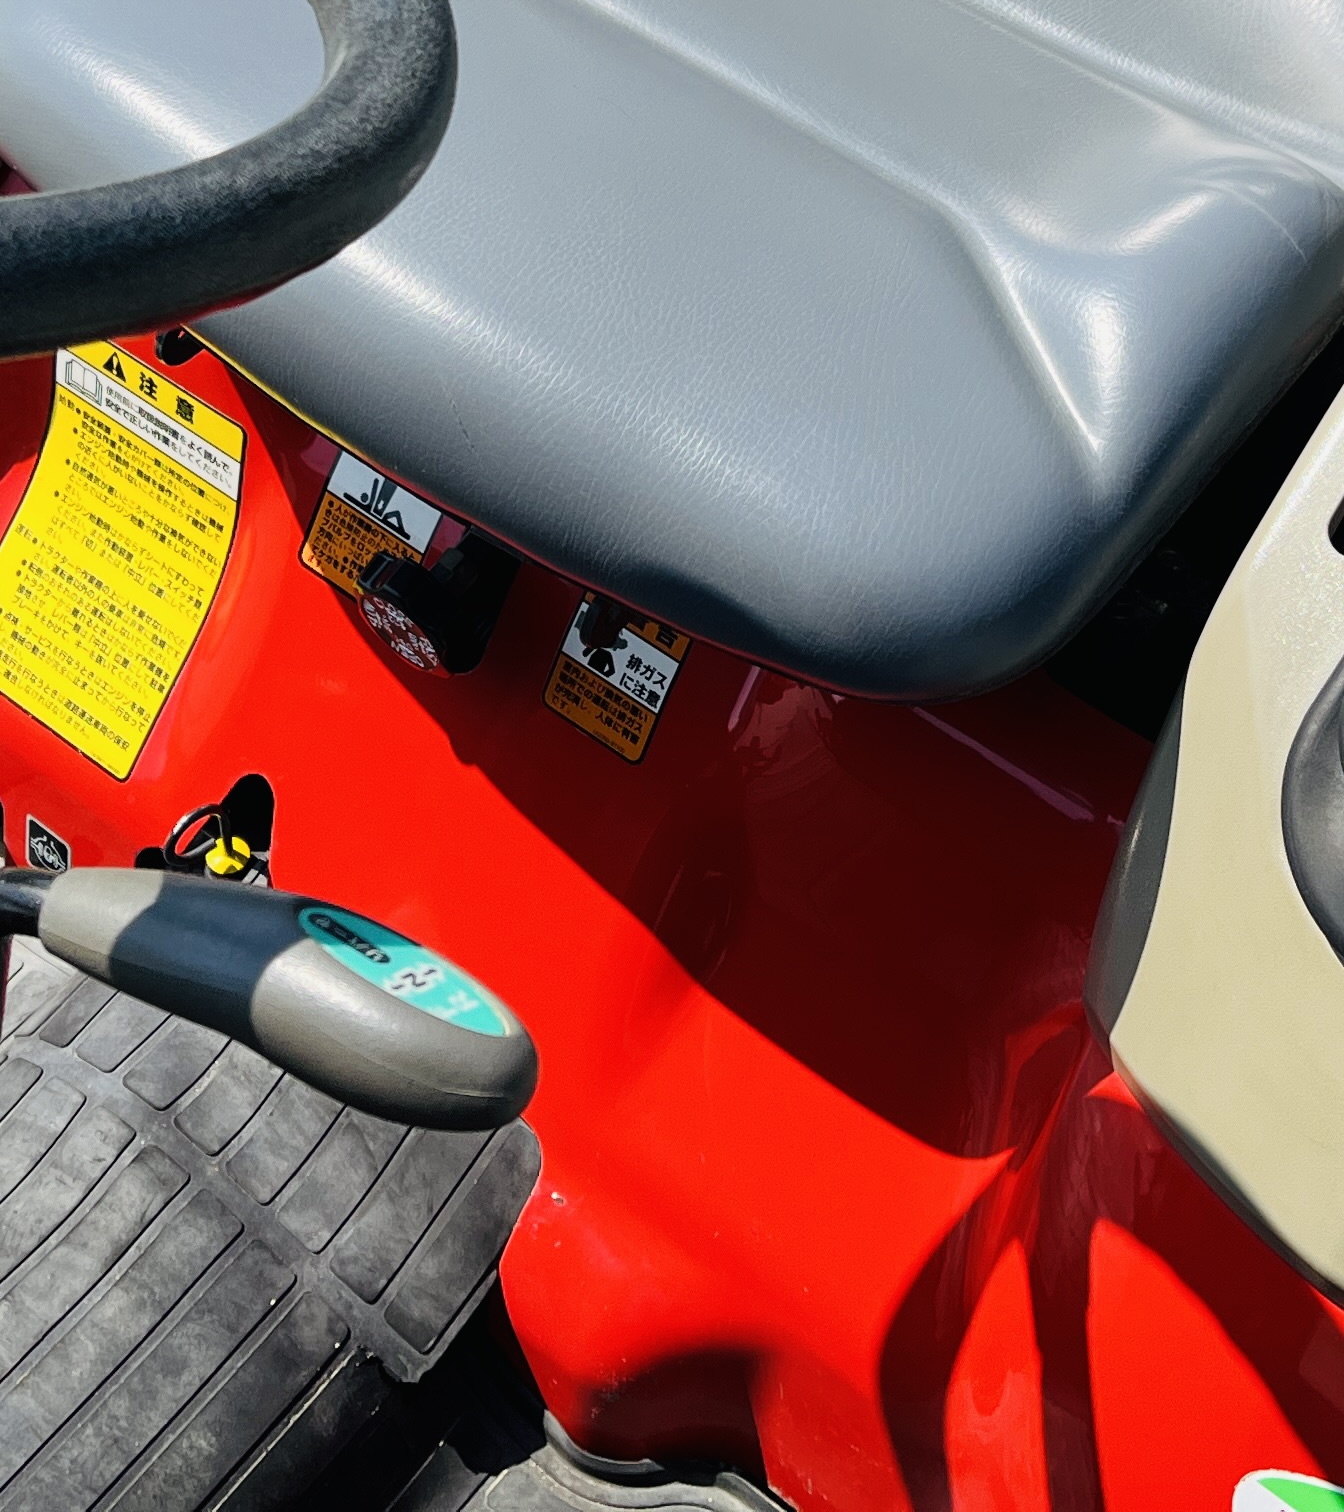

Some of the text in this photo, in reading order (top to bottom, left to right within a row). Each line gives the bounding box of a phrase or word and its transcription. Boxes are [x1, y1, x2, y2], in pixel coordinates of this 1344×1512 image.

[625, 653, 669, 690] 排ガス
[619, 672, 661, 709] に注意
